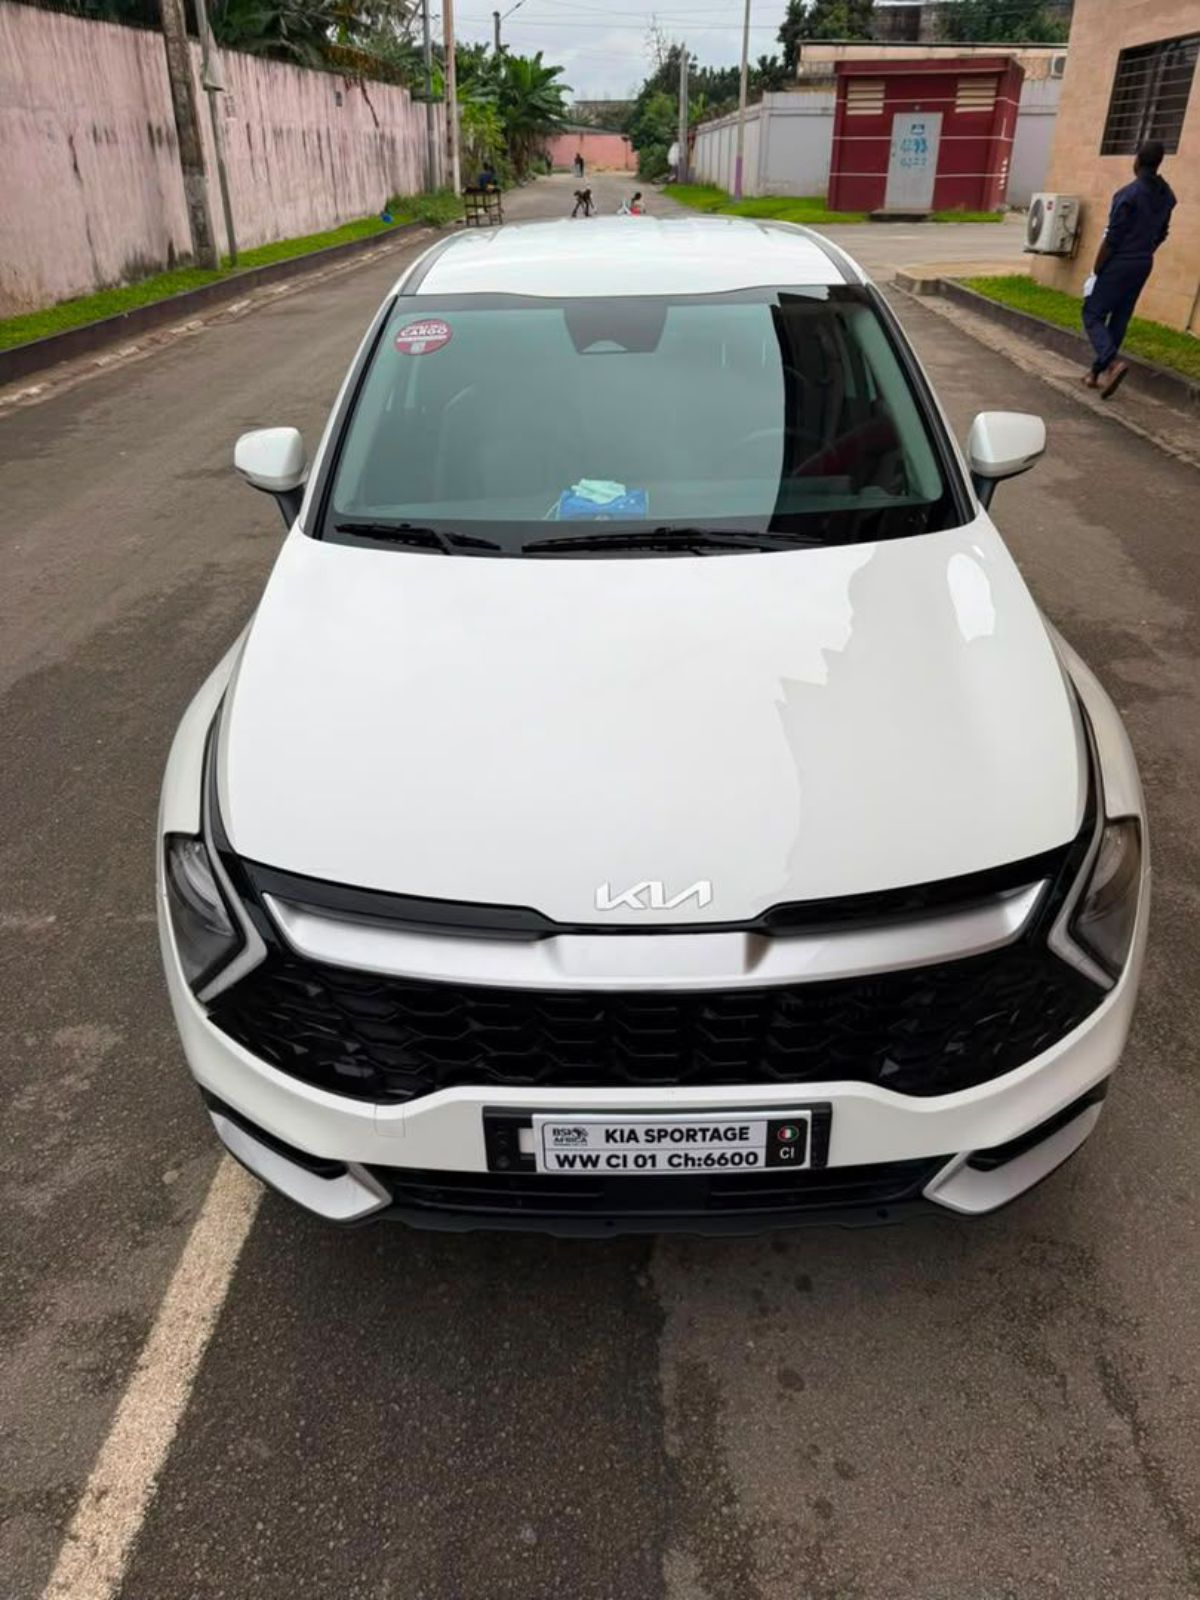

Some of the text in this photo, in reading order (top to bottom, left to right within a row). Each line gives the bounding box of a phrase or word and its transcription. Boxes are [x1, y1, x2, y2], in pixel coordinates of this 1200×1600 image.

[595, 880, 712, 910] KIA
[605, 1126, 750, 1143] KIA SPORTAGE
[555, 1151, 759, 1168] WW CI 01 Ch:6600
[779, 1146, 795, 1159] CI
